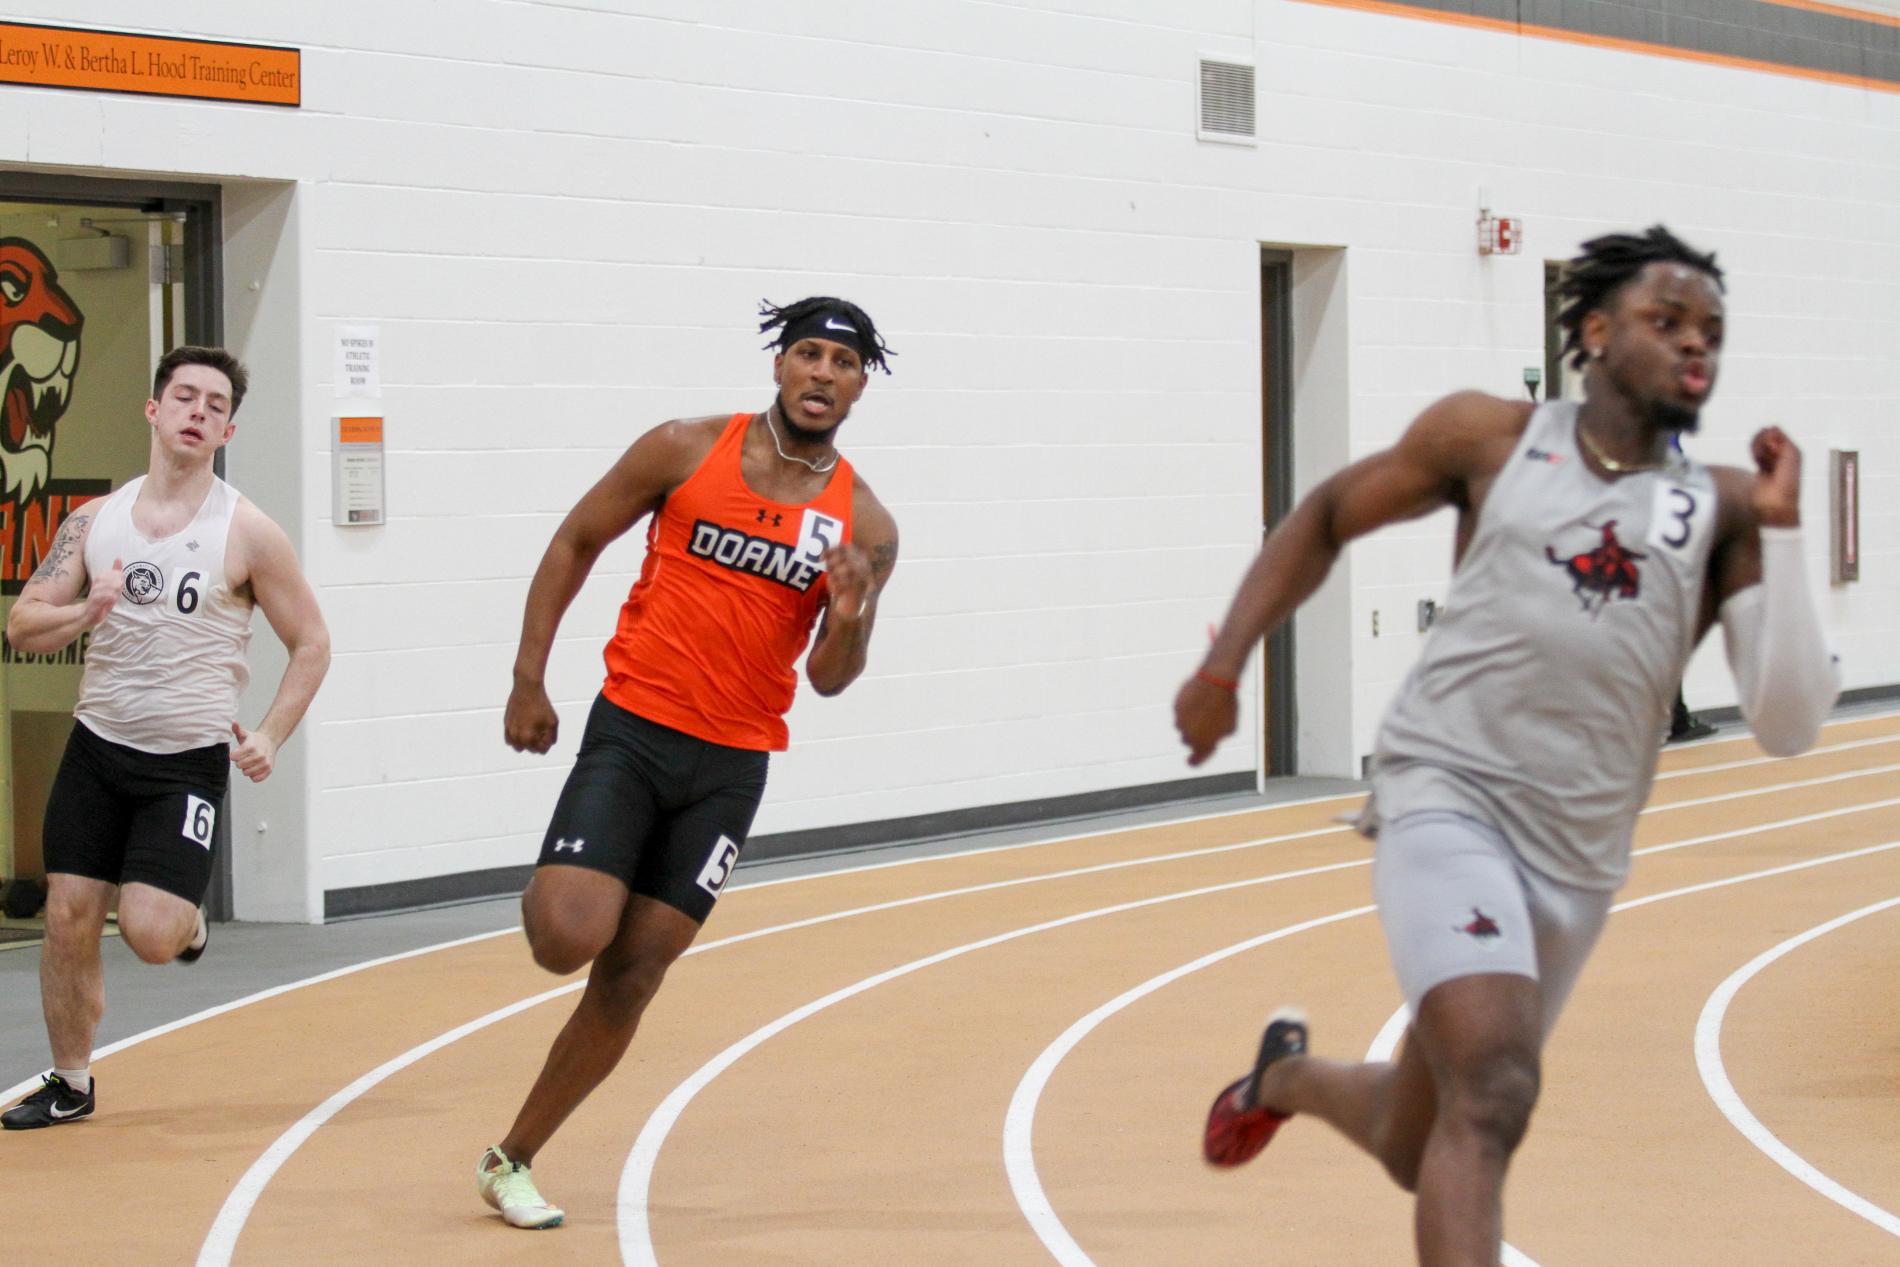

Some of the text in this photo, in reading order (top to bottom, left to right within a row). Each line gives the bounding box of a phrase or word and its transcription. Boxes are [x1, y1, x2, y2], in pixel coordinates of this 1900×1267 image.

[0, 39, 295, 90] Leroy W. & Bertha L. Hood Training Center
[805, 515, 834, 563] 5
[1662, 489, 1696, 548] 3
[690, 524, 818, 593] DOANE
[176, 571, 201, 614] 6
[193, 803, 211, 841] 6
[706, 844, 737, 891] 5
